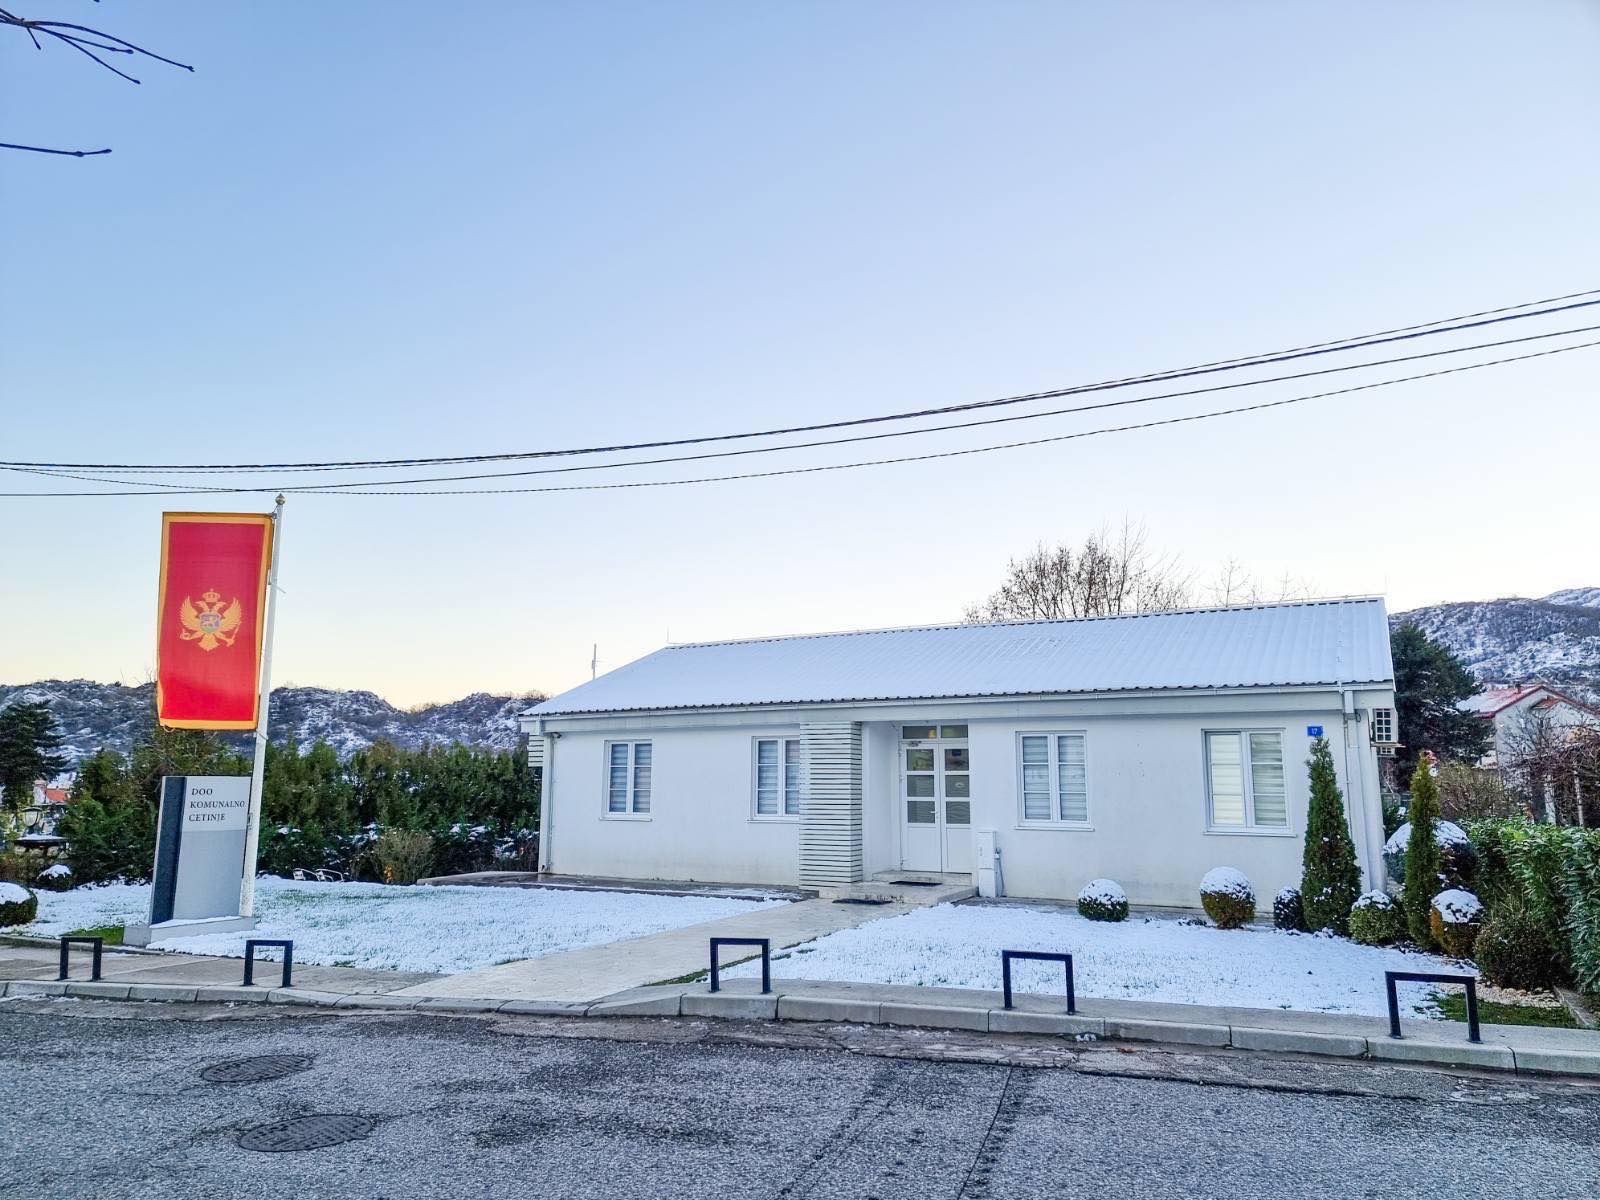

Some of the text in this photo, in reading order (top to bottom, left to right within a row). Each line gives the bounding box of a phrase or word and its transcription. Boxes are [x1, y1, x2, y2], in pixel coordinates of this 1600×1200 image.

[191, 787, 213, 796] DOO
[190, 800, 246, 809] KOMUNALNO
[188, 813, 226, 822] CETINJE
